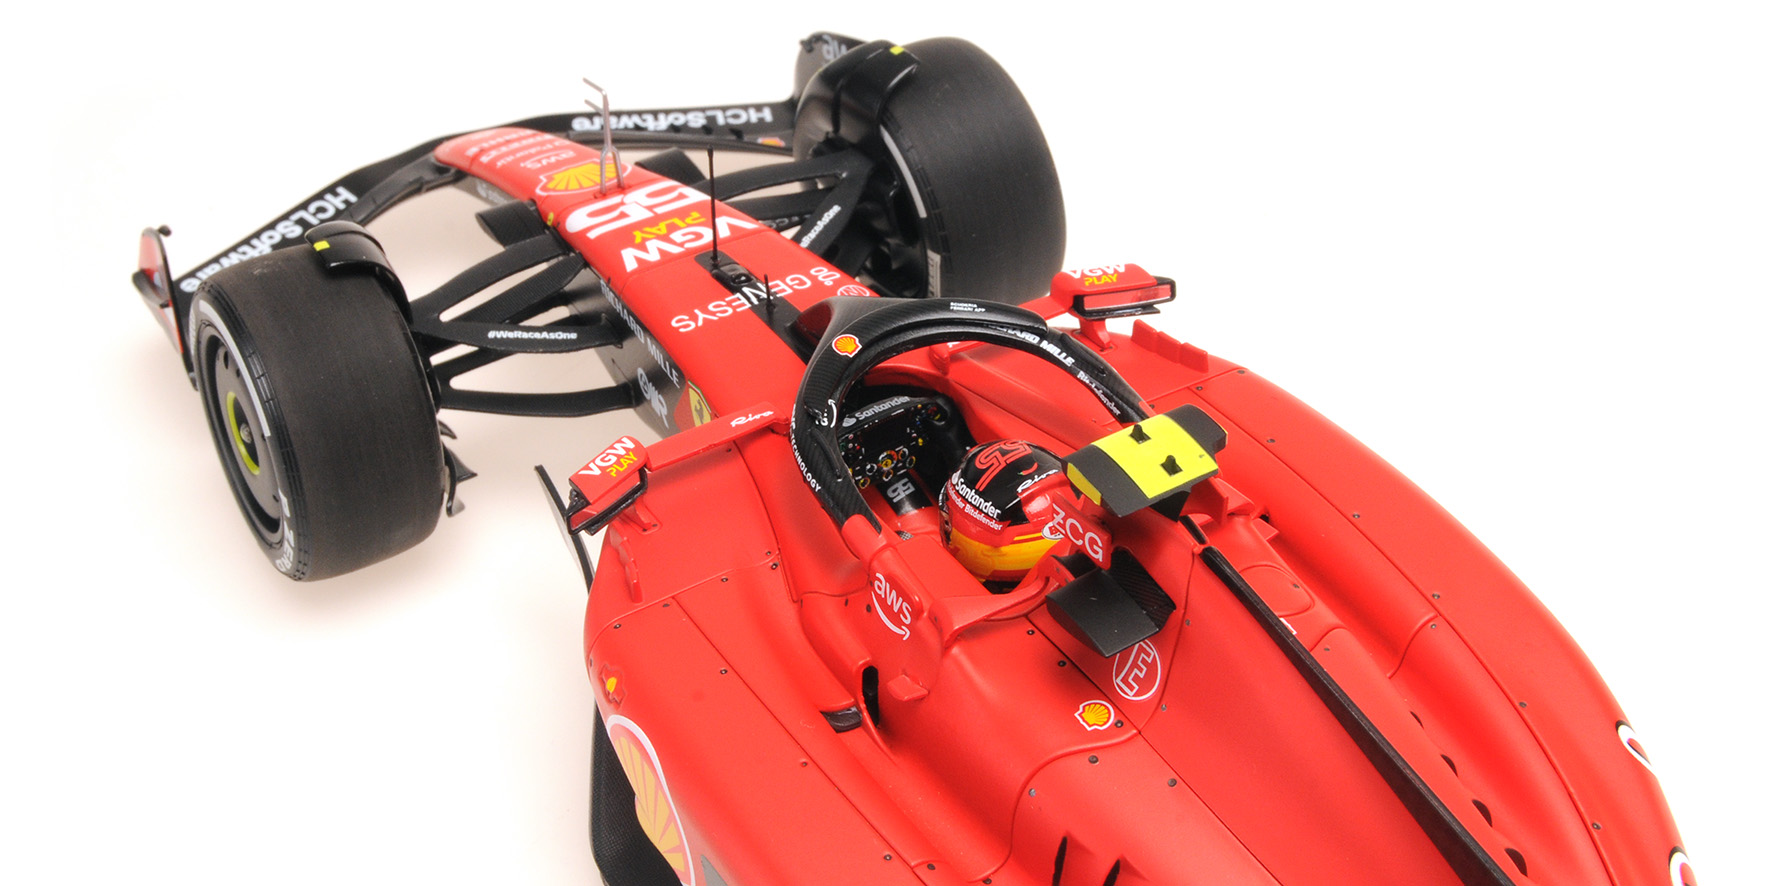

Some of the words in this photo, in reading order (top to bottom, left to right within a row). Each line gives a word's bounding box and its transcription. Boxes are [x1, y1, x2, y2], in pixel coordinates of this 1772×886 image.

[571, 106, 774, 131] HCLSoftware
[565, 180, 712, 240] 55
[179, 185, 358, 293] HCLSoftware
[620, 215, 760, 273] VGW
[632, 211, 706, 244] PLAY
[1066, 263, 1126, 278] VGW
[1084, 273, 1118, 286] PLAY
[671, 274, 812, 333] GENESYS
[487, 329, 578, 341] #WeRaceAsOne
[600, 279, 645, 344] RICHARD
[646, 337, 681, 390] MILLE
[1040, 340, 1075, 367] MILLE
[730, 410, 775, 427] Riva
[854, 395, 911, 421] Santander
[578, 437, 636, 478] VGW
[606, 452, 638, 477] PLAY
[789, 433, 822, 492] TECHNOLOGY
[974, 440, 1033, 492] 55
[886, 478, 916, 503] 55
[1016, 468, 1059, 493] Riva
[955, 477, 1002, 519] Santander
[964, 504, 1003, 531] Bitdefender
[275, 520, 295, 572] ZERO
[872, 573, 912, 628] aws
